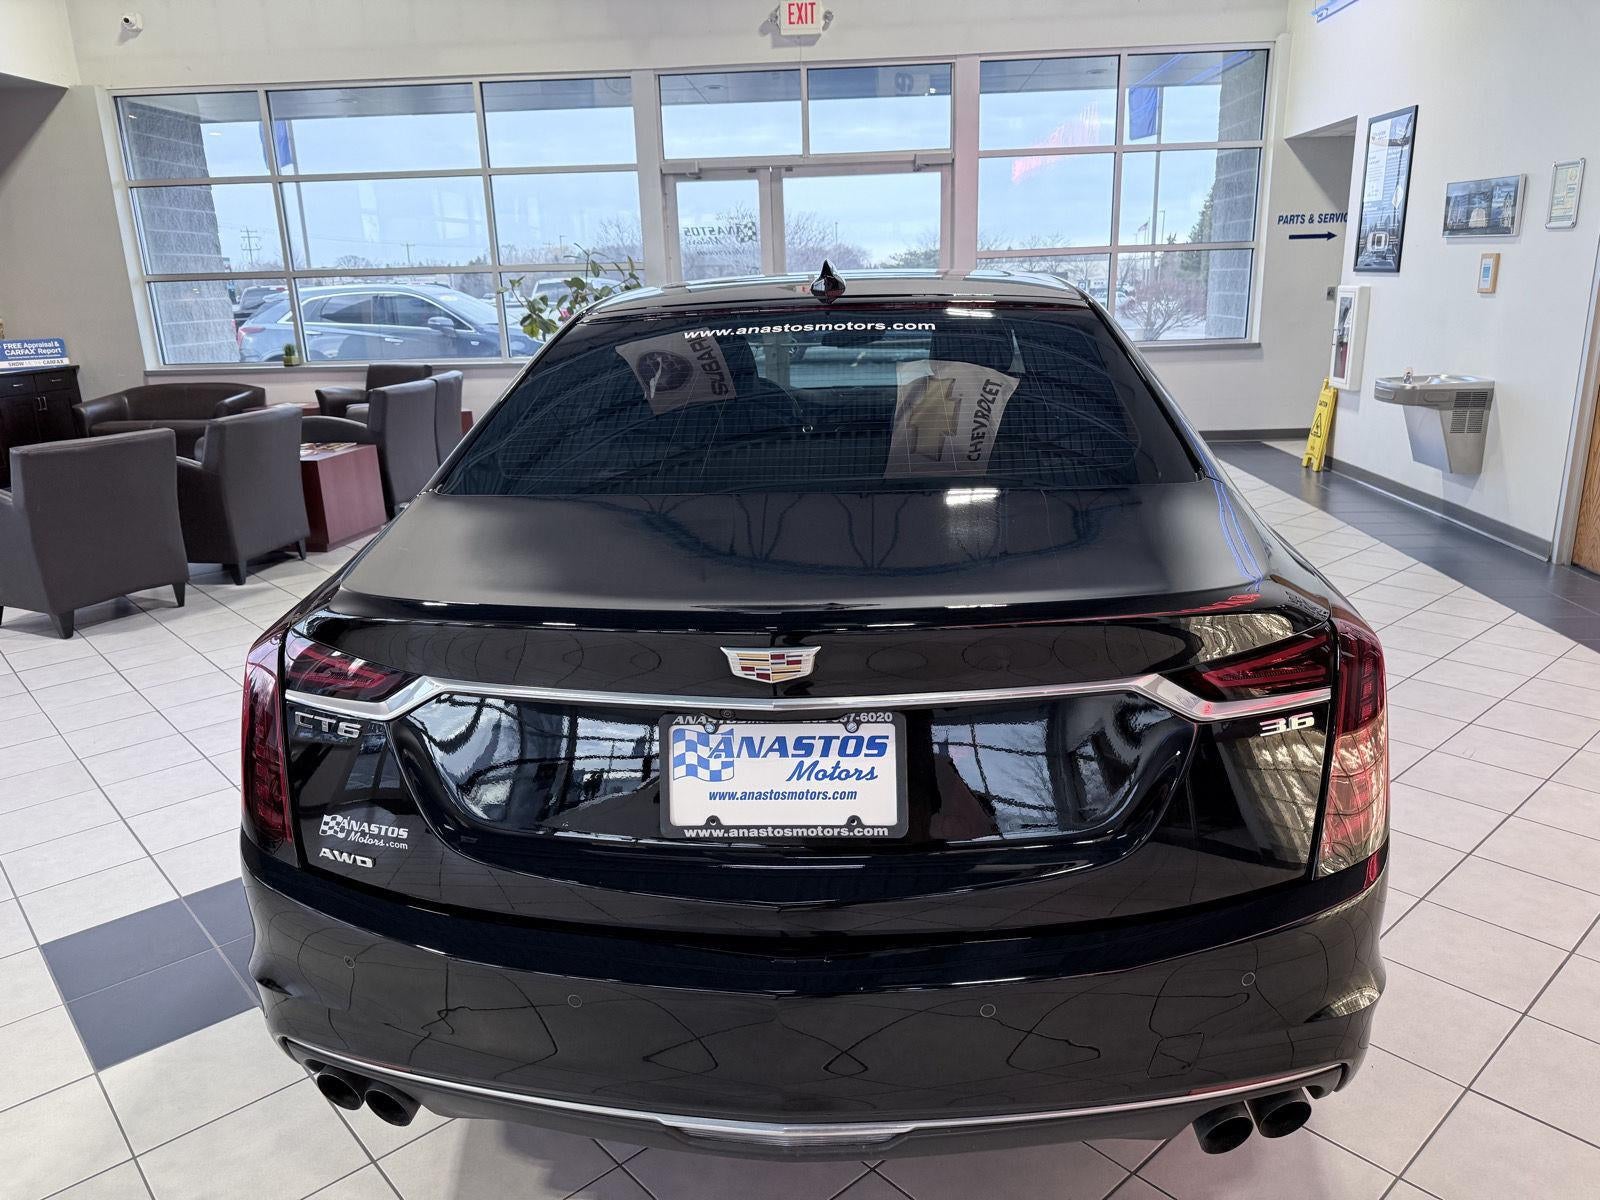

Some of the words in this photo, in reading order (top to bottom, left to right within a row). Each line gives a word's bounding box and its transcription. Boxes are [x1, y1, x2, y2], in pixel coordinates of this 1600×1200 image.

[788, 2, 816, 25] EXIT
[1278, 214, 1306, 225] PARTS
[1308, 213, 1315, 224] &
[684, 321, 936, 339] www.anastosmotors.com
[23, 341, 54, 350] Appraisal
[967, 379, 1002, 461] CHEVROLET
[295, 711, 362, 739] CT6
[1260, 711, 1315, 737] 3.6
[707, 735, 889, 759] ANASTOS
[785, 760, 878, 782] Motors
[708, 789, 857, 801] www.anastosmotors.com
[340, 817, 409, 839] ANASTOS
[684, 826, 889, 838] www.anastosmotors.com
[319, 848, 374, 868] AWD
